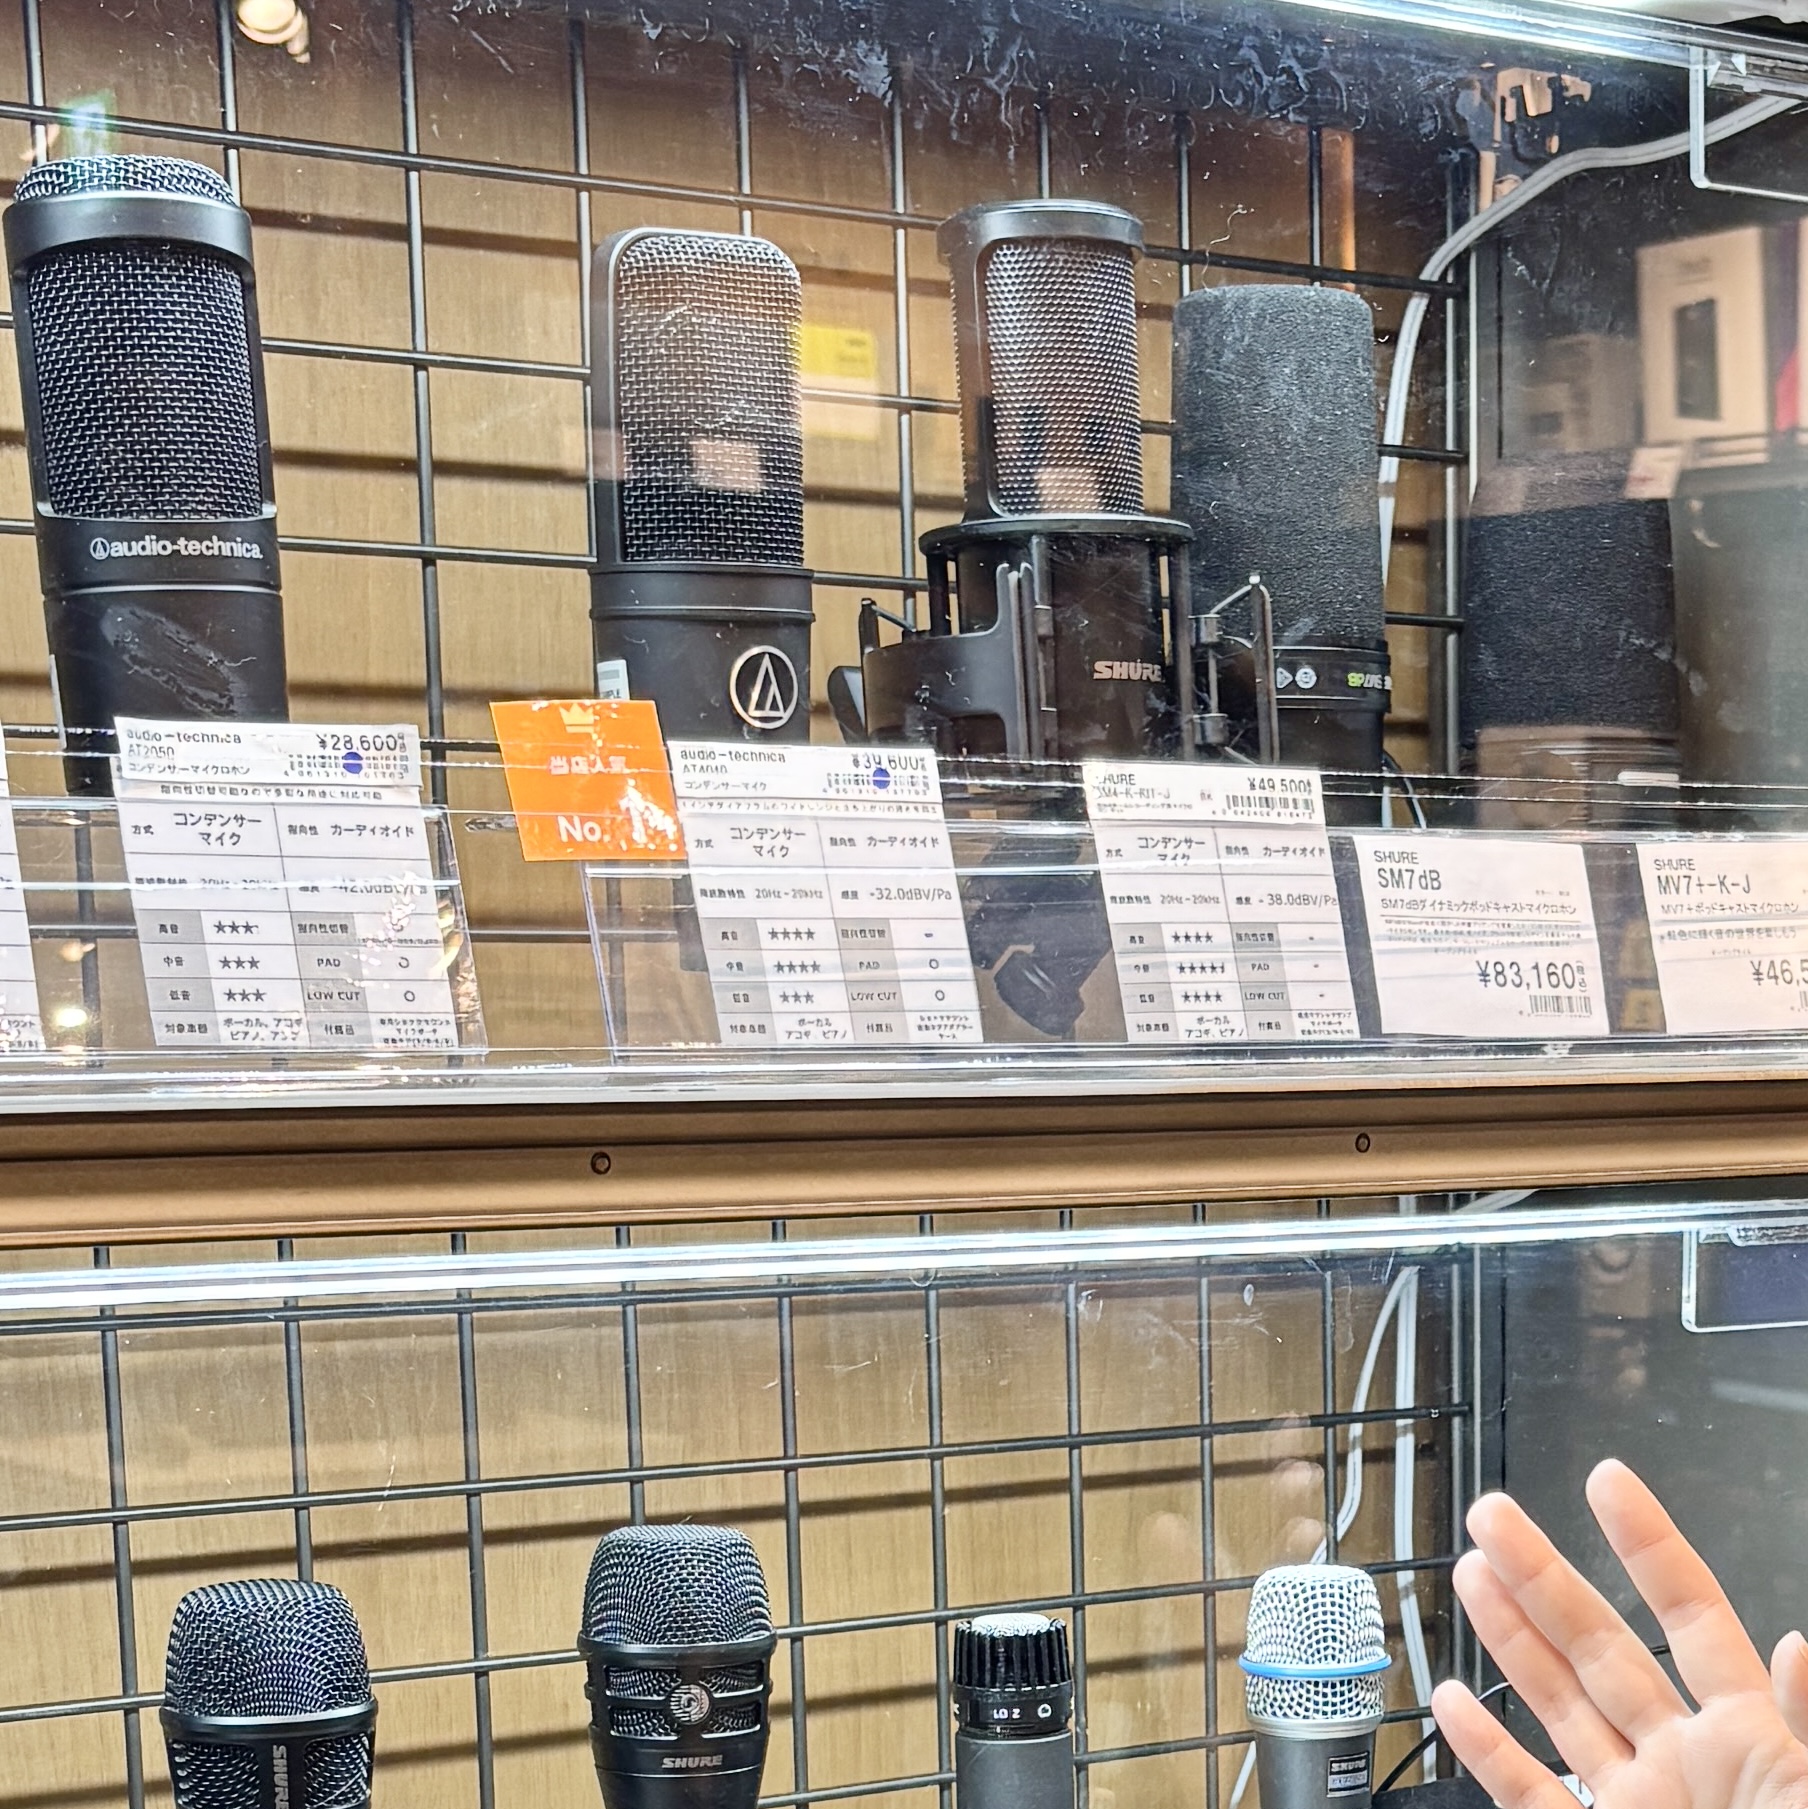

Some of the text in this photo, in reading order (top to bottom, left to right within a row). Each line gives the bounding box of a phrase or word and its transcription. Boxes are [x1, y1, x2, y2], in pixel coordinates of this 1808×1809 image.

[1093, 661, 1165, 682] SHURE
[127, 731, 241, 743] audio-technica
[680, 749, 785, 764] audio-technica
[1093, 773, 1136, 785] HURE
[685, 780, 767, 792] コンデンサーマイク
[173, 812, 262, 827] コンデンサー
[331, 825, 414, 836] カーディオイド
[730, 827, 806, 840] コンデンサー
[199, 833, 242, 846] マイク
[867, 836, 939, 847] カーディオイド
[1137, 837, 1206, 849] コンデンサー
[753, 846, 790, 857] マイク
[1263, 846, 1325, 856] カーディオイド
[1374, 851, 1419, 864] SHURE
[1654, 859, 1695, 870] SHURE
[1378, 868, 1441, 890] SM7dB
[1658, 875, 1751, 895] MV7+-K-J
[317, 958, 340, 968] PAD
[859, 961, 880, 970] PAD
[1252, 963, 1269, 971] PAD
[1476, 961, 1575, 990] ¥83,160
[307, 991, 360, 1000] LOW CUT
[851, 992, 897, 1001] LOW CUT
[1245, 992, 1284, 1000] LOW CUT
[661, 1753, 723, 1768] SHURE
